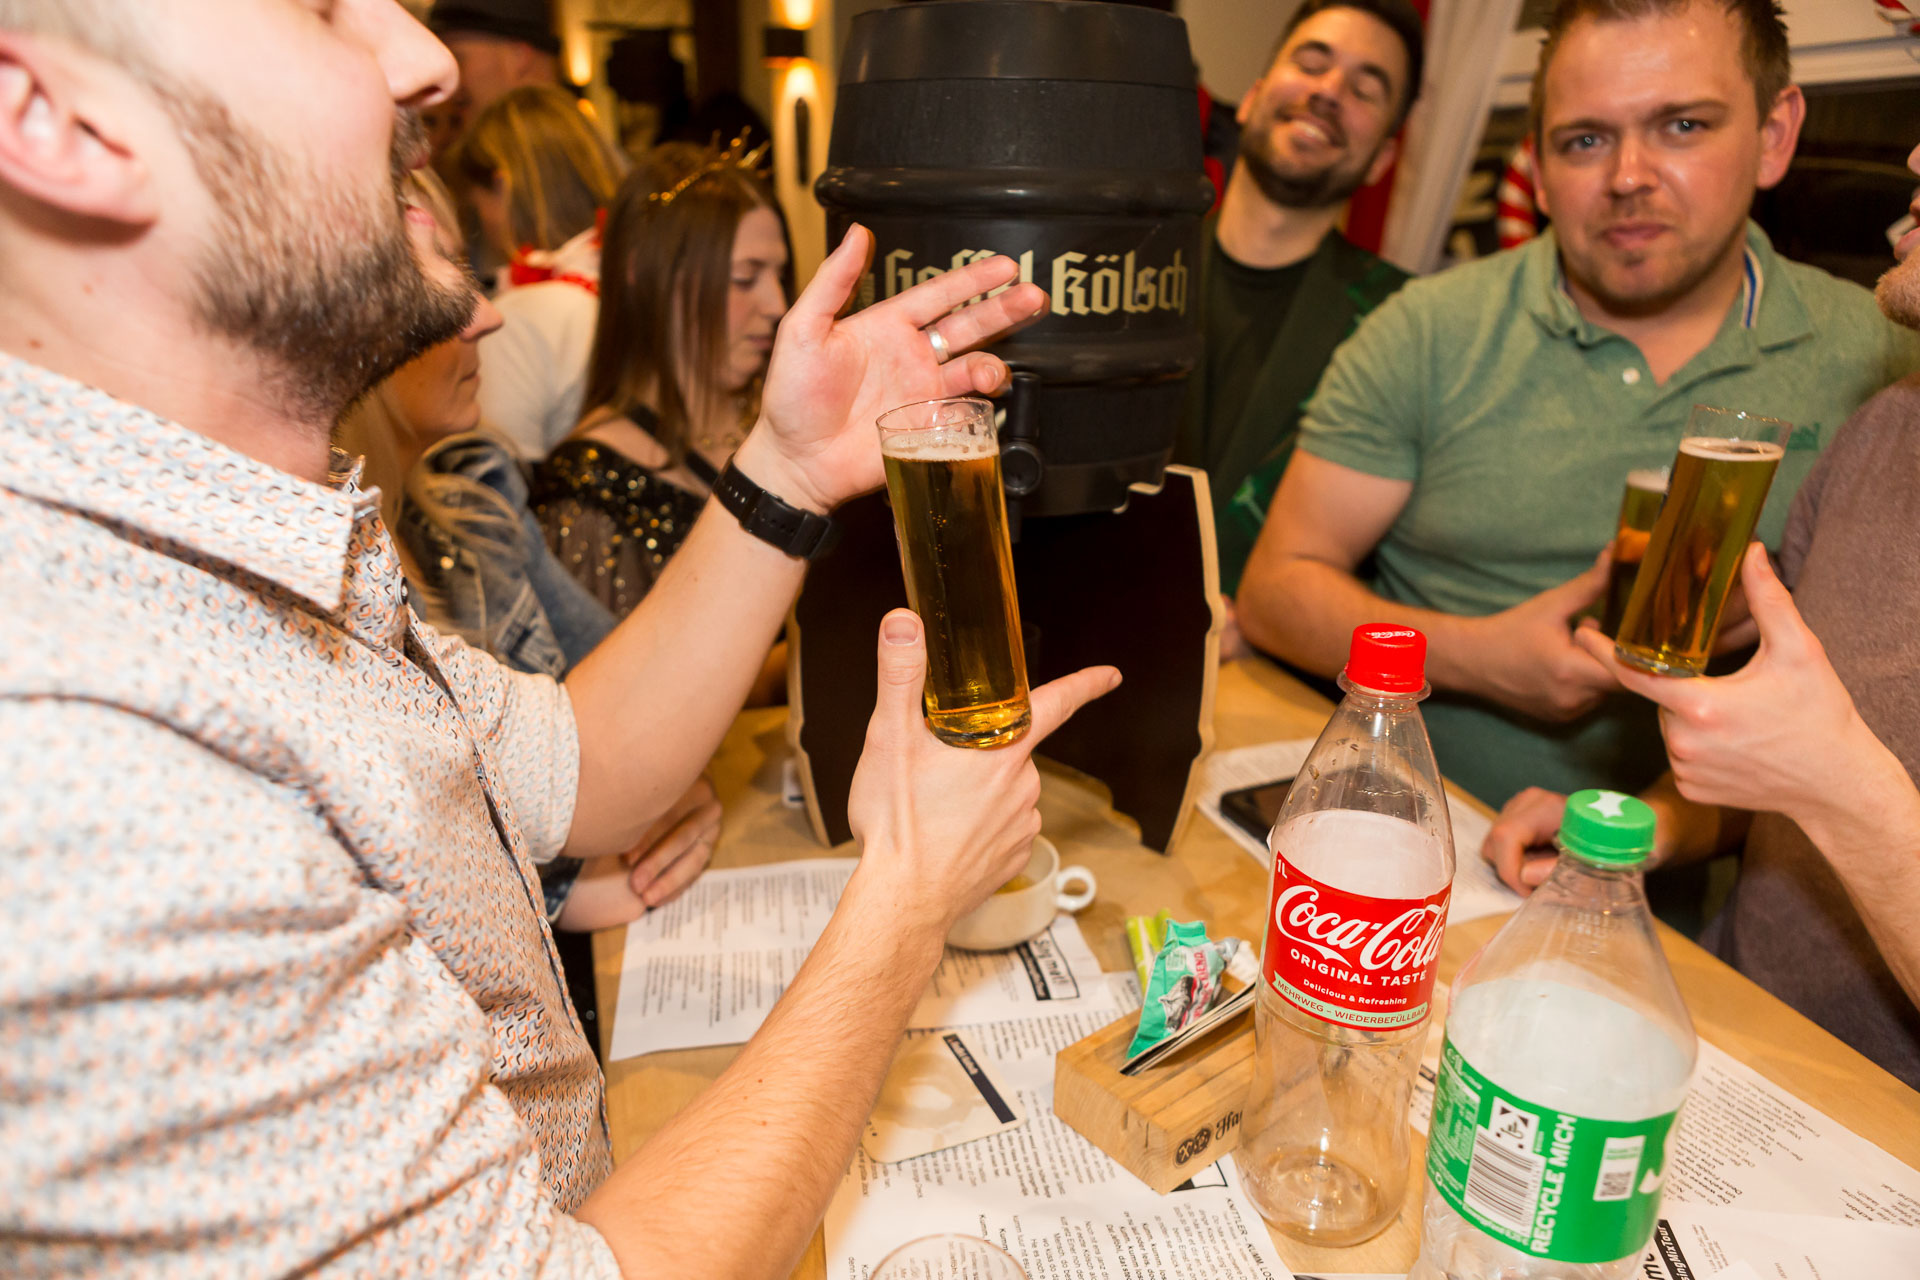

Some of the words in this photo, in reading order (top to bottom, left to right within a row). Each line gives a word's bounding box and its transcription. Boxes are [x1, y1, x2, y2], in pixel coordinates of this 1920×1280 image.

[1051, 249, 1188, 317] Kölsch
[1277, 859, 1288, 879] 1L
[1275, 885, 1450, 972] Coca-Cola
[1290, 948, 1373, 986] ORIGINAL
[1380, 969, 1427, 987] TASTE
[1277, 980, 1325, 1012] MEHRWEG
[1334, 1007, 1426, 1025] WIEDERBEFÜLLBAR
[1303, 978, 1346, 1000] Delicious
[1348, 994, 1356, 1002] &
[1358, 996, 1408, 1006] Refreshing
[1530, 1169, 1566, 1254] RECYCLE
[1549, 1114, 1577, 1168] MICH
[1226, 1197, 1247, 1235] KNITTLER
[1042, 1238, 1048, 1247] wo
[1049, 1263, 1056, 1271] do
[1067, 1238, 1076, 1254] Einer
[1136, 1236, 1145, 1250] oder
[1150, 1243, 1161, 1267] kumm,
[1035, 1258, 1044, 1273] noch
[1061, 1259, 1067, 1267] do
[1082, 1249, 1093, 1269] Kölsch
[1118, 1255, 1126, 1266] dat
[1128, 1245, 1138, 1267] kumm
